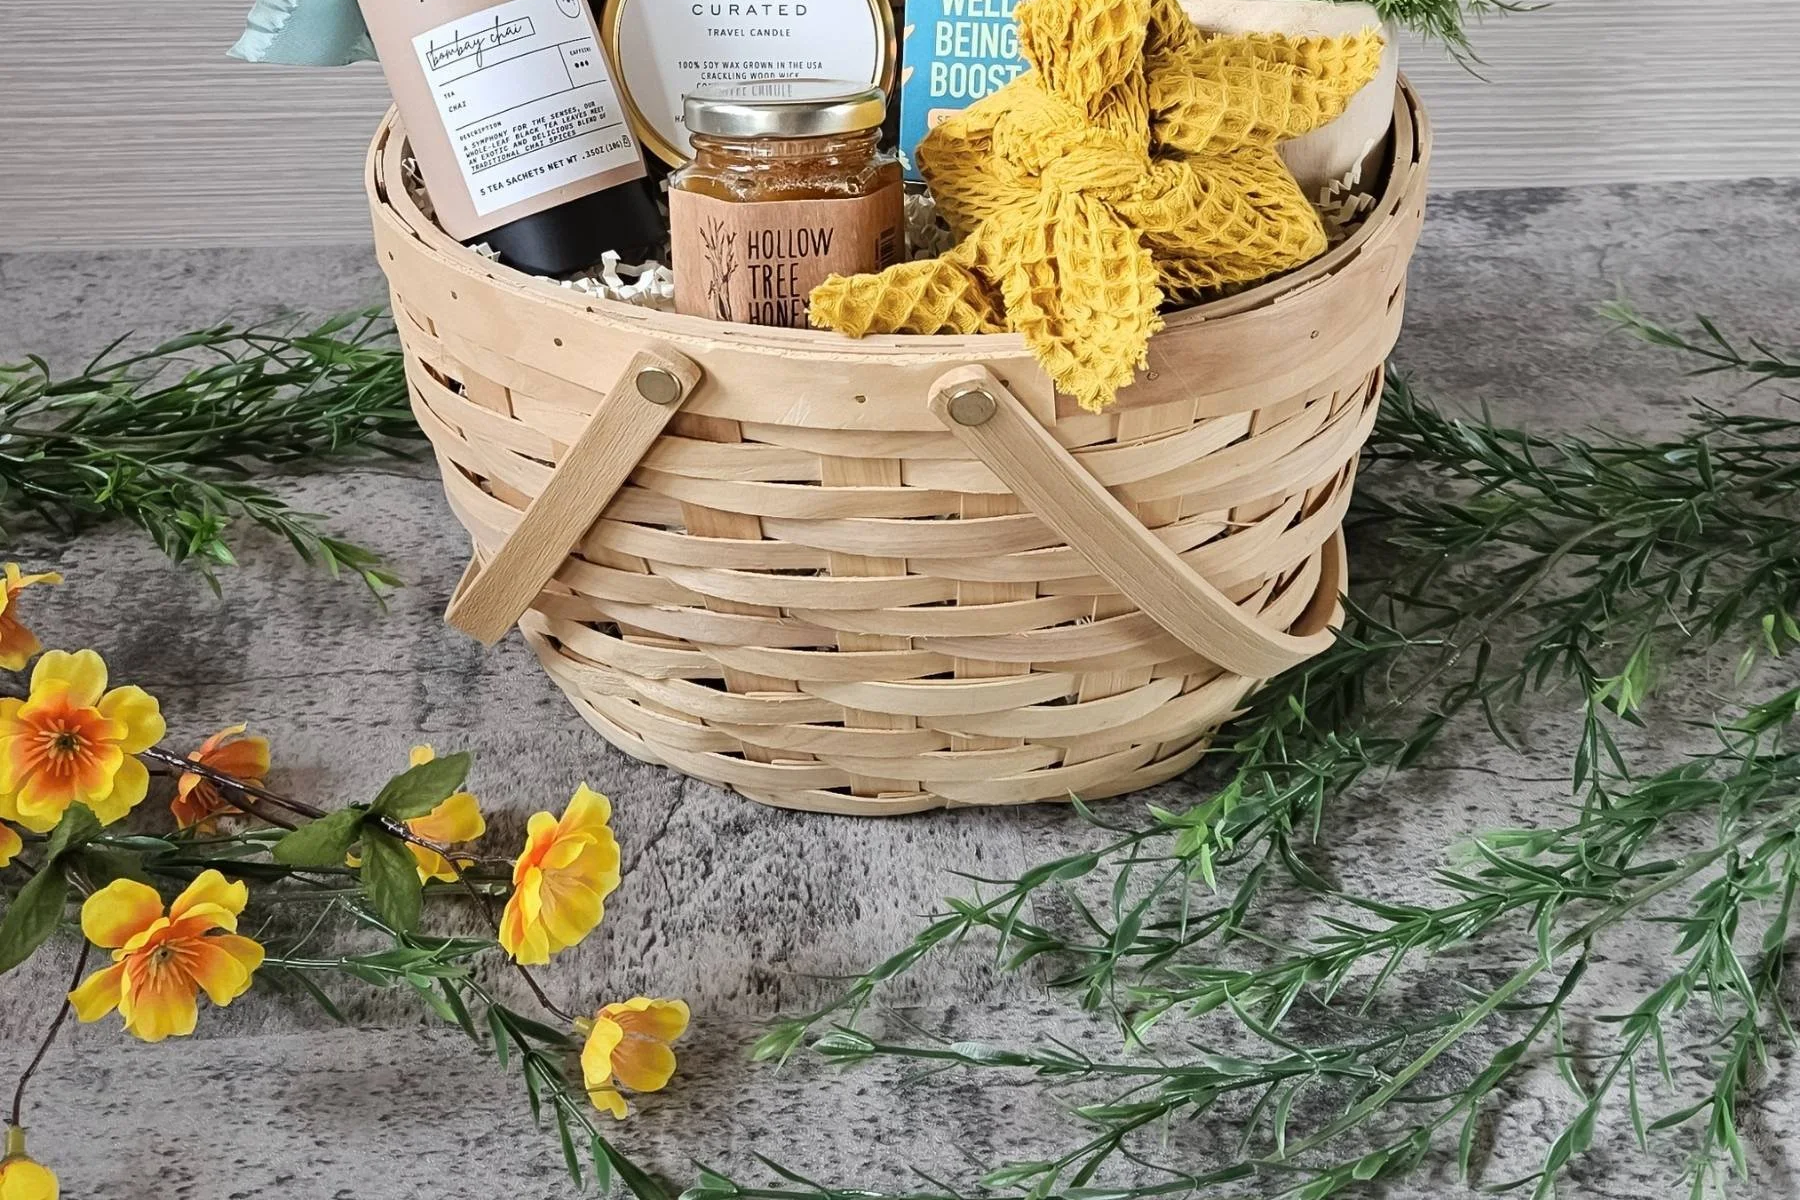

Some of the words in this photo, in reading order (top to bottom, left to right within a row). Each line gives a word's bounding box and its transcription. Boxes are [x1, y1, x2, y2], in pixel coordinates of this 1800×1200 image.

[691, 4, 807, 16] CURATED
[430, 30, 485, 67] bombay
[490, 16, 522, 45] chai
[707, 28, 745, 37] TRAVEL
[750, 28, 791, 37] CANDLE
[936, 21, 1018, 58] BEING
[678, 61, 700, 70] 100%
[703, 61, 719, 70] SOY
[722, 61, 740, 70] WAX
[743, 61, 773, 70] GROWN
[776, 61, 785, 70] IN
[789, 61, 803, 70] THE
[806, 61, 823, 70] USA
[701, 72, 747, 80] CRACKLING
[930, 61, 1023, 99] BOOST
[448, 100, 467, 113] CHAI
[471, 130, 508, 149] SYMPHONY
[512, 123, 528, 133] FOR
[532, 117, 546, 126] THE
[583, 101, 596, 109] OUR
[465, 137, 510, 158] WHOLE-LEAF
[515, 126, 539, 140] BLACK
[544, 120, 558, 129] TEA
[562, 111, 588, 123] LEAVES
[468, 157, 477, 165] AN
[481, 145, 509, 160] EXOTIC
[513, 139, 528, 148] AND
[532, 123, 574, 142] DELICIOUS
[577, 116, 597, 127] BLEND
[471, 150, 520, 172] TRADITIONAL
[524, 140, 544, 152] CHAI
[549, 129, 576, 144] SPICES
[487, 181, 504, 193] TEA
[505, 166, 545, 186] SACHETS
[547, 159, 564, 172] NET
[566, 154, 578, 164] WT
[747, 227, 833, 260] HOLLOW
[747, 262, 800, 299] TREE
[748, 298, 811, 329] HONEY
